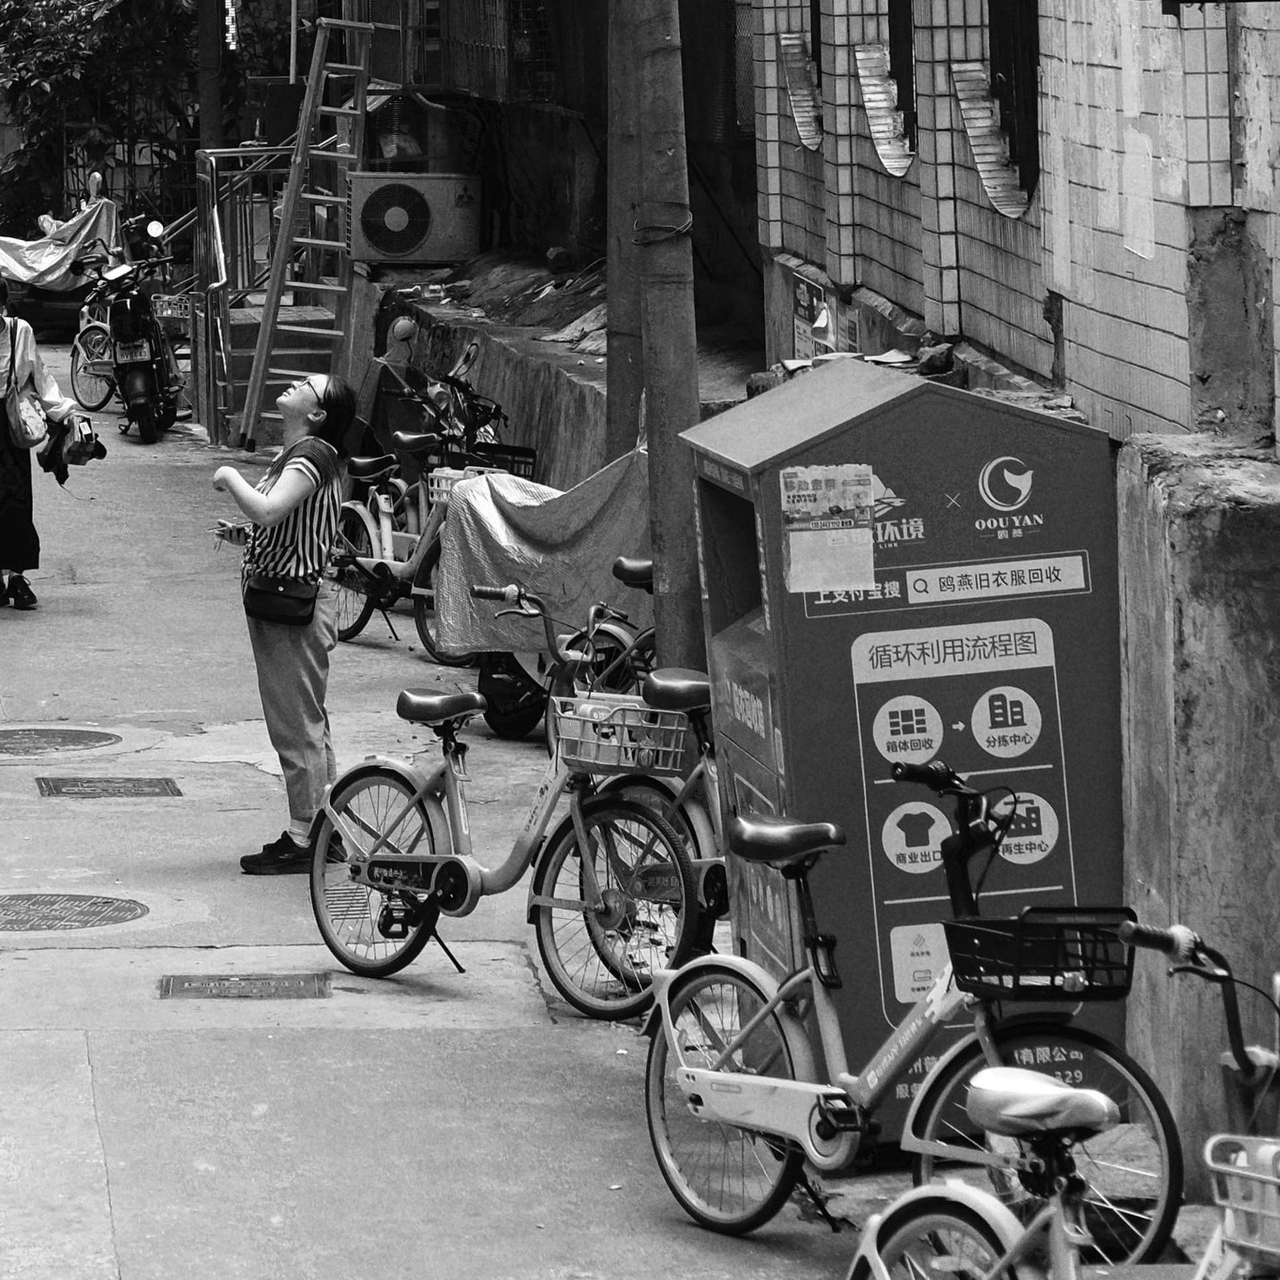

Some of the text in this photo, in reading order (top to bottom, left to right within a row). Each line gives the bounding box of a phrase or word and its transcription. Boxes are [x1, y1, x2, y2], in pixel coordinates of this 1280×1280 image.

[873, 517, 926, 543] 环境
[938, 566, 1062, 593] 鸥燕旧衣服回收
[868, 631, 1038, 670] 循环利用流程图
[885, 737, 934, 753] 箱体回收
[986, 733, 1034, 748] 分拣中心
[1001, 841, 1050, 856] 再生中心
[895, 850, 942, 865] 商业出口
[1013, 1046, 1084, 1064] 有限公司
